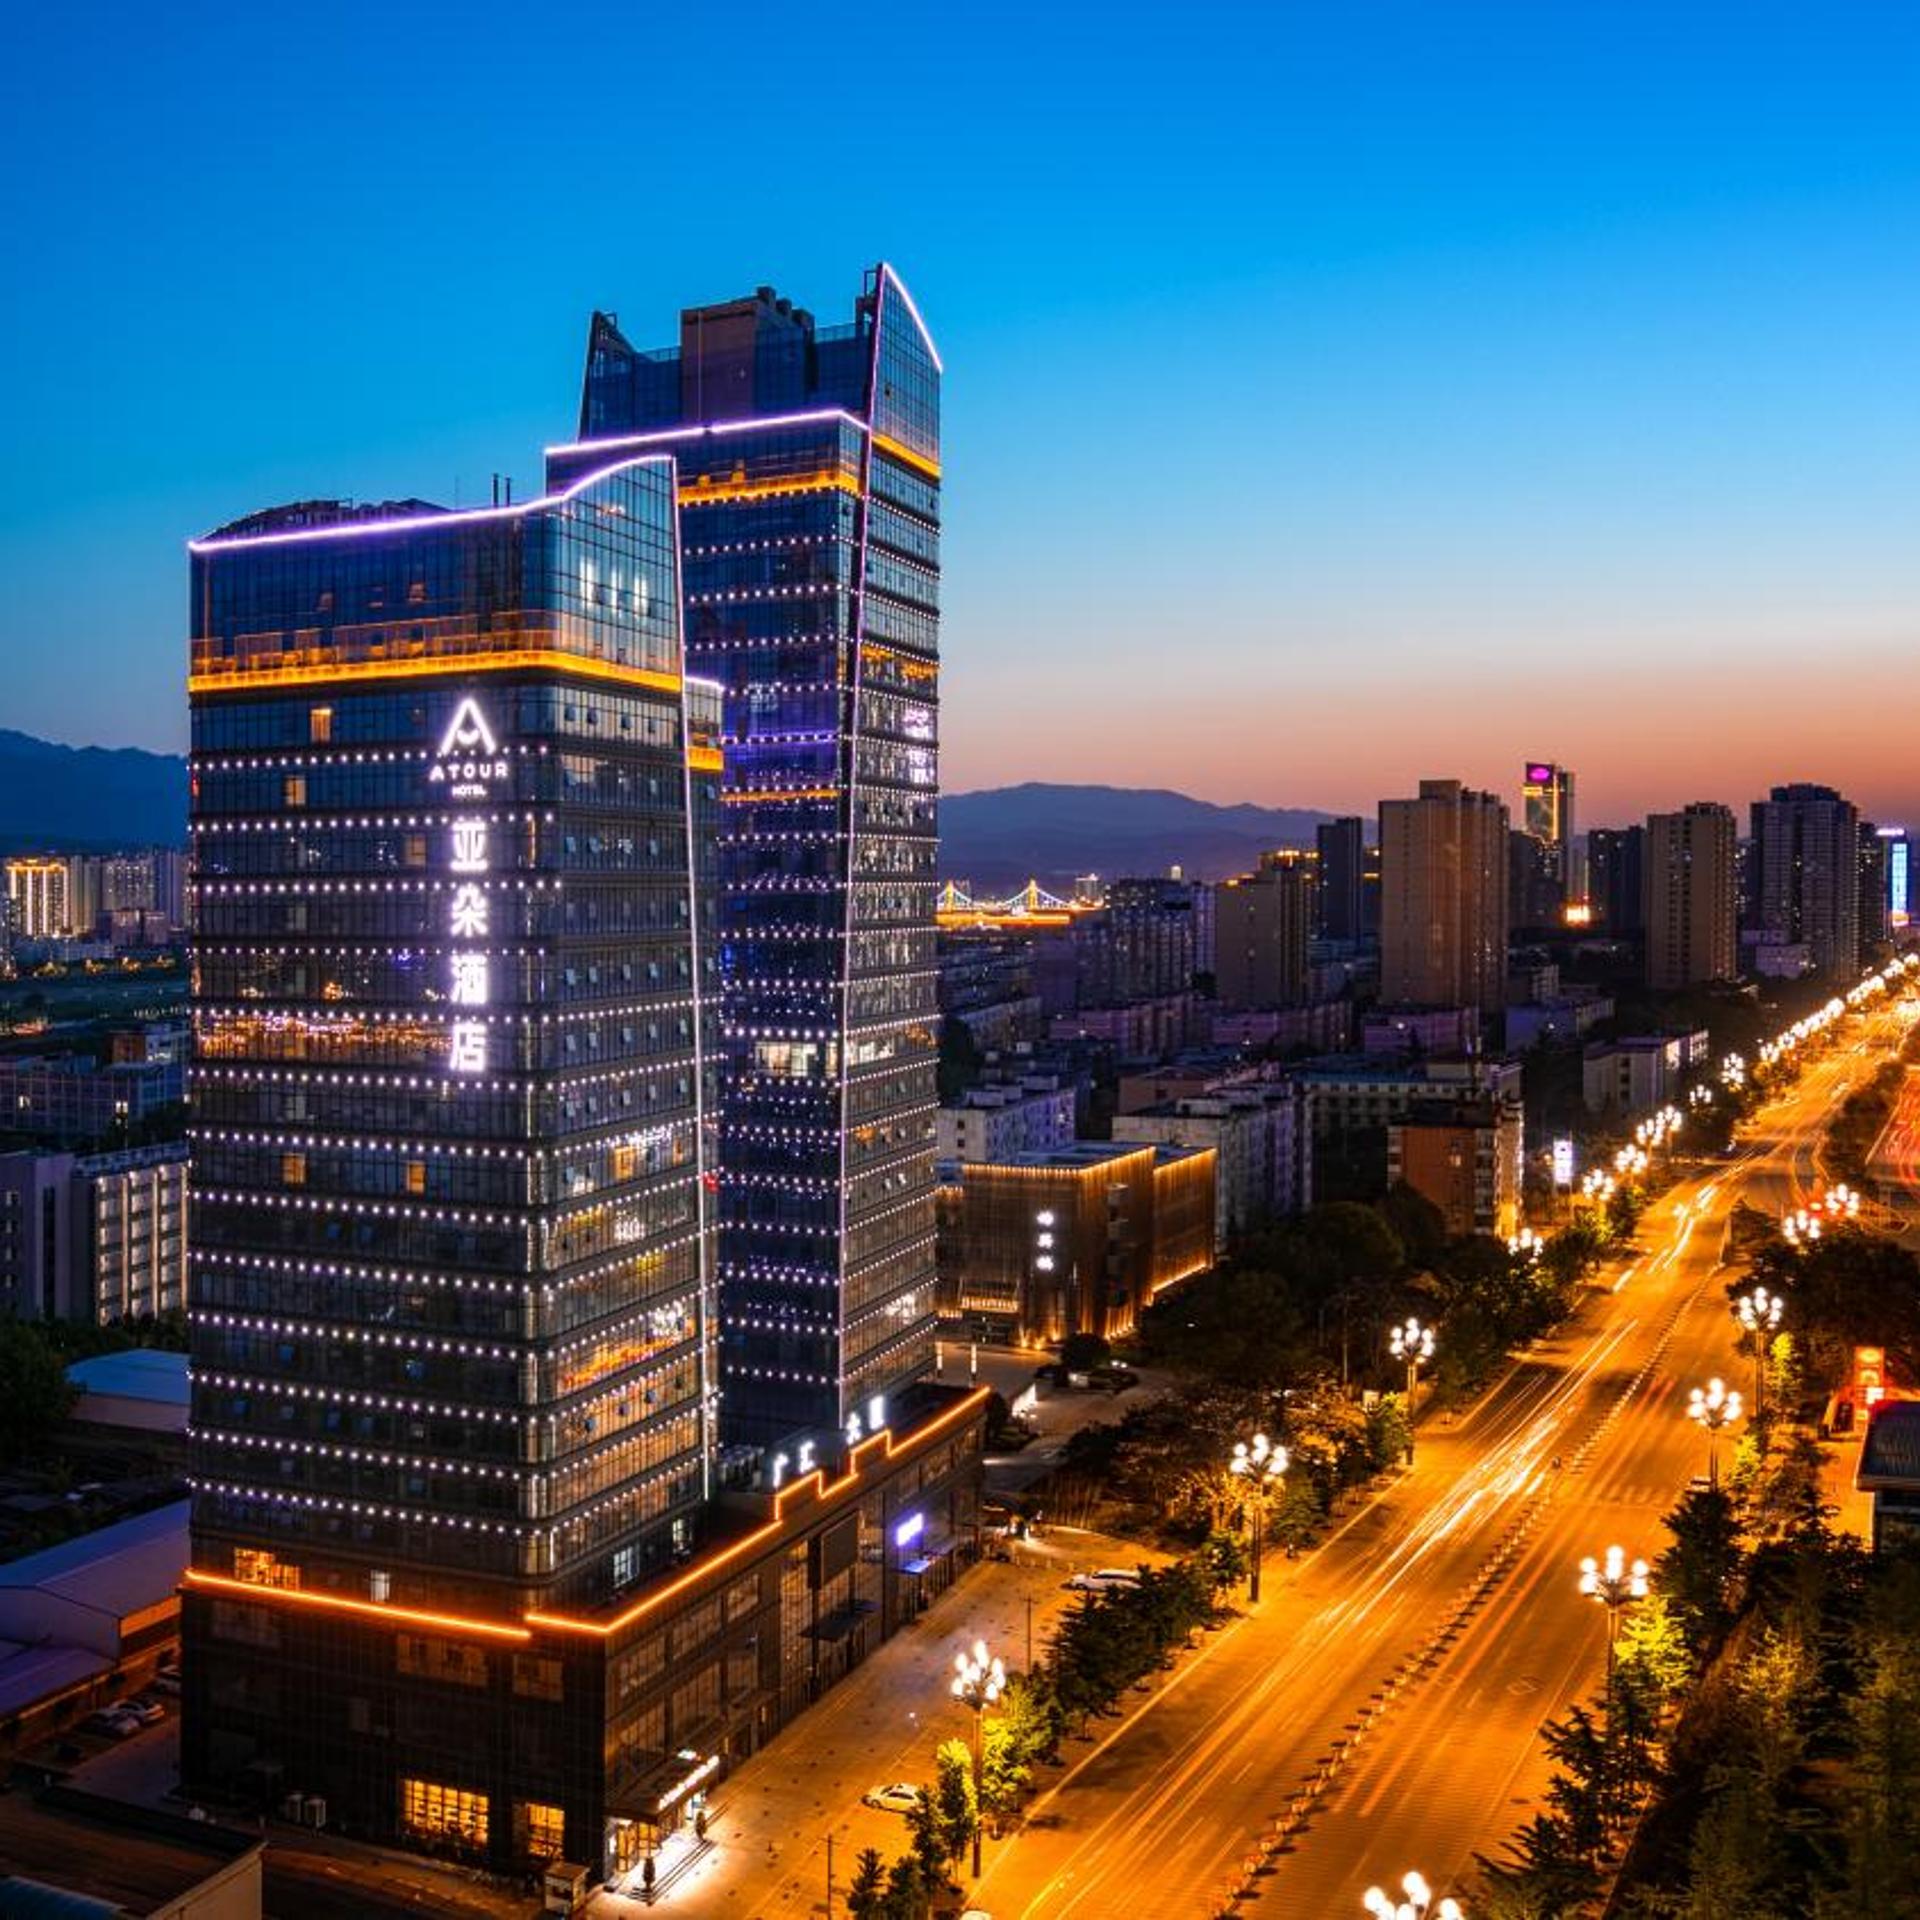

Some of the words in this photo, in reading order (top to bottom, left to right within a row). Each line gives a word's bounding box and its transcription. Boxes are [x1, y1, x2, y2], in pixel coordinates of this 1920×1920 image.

[429, 762, 508, 781] ATOUR
[452, 784, 487, 797] HOTEL
[450, 821, 489, 1073] 亚朵酒店
